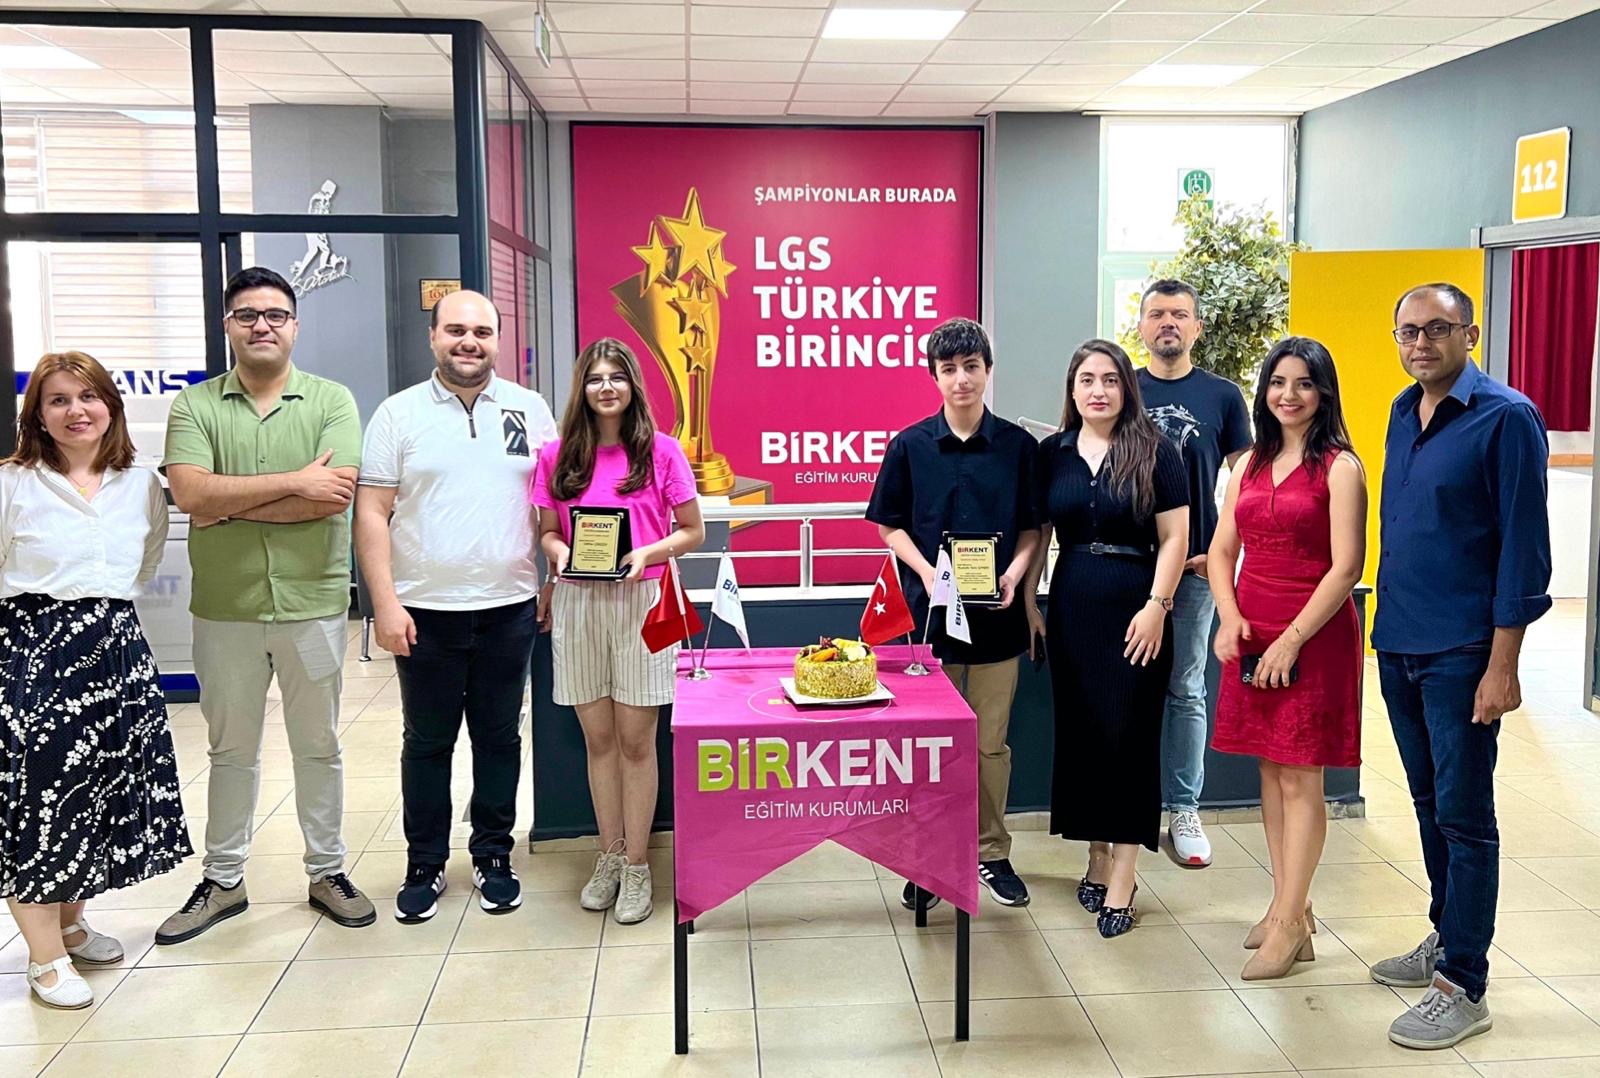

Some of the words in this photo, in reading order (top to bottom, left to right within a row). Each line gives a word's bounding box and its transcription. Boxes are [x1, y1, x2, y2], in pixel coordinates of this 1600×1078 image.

[1520, 159, 1558, 194] 112
[754, 184, 881, 206] ŞAMPİYONLAR
[885, 187, 957, 203] BURADA
[755, 236, 832, 271] LGS
[753, 276, 938, 319] TÜRKİYE
[761, 431, 900, 464] BİRKE
[795, 471, 838, 484] EĞİTİM
[842, 472, 879, 484] KURU
[698, 736, 953, 792] BİRKENT
[744, 800, 804, 820] EĞİTİM
[809, 798, 909, 818] KURUMLARI
